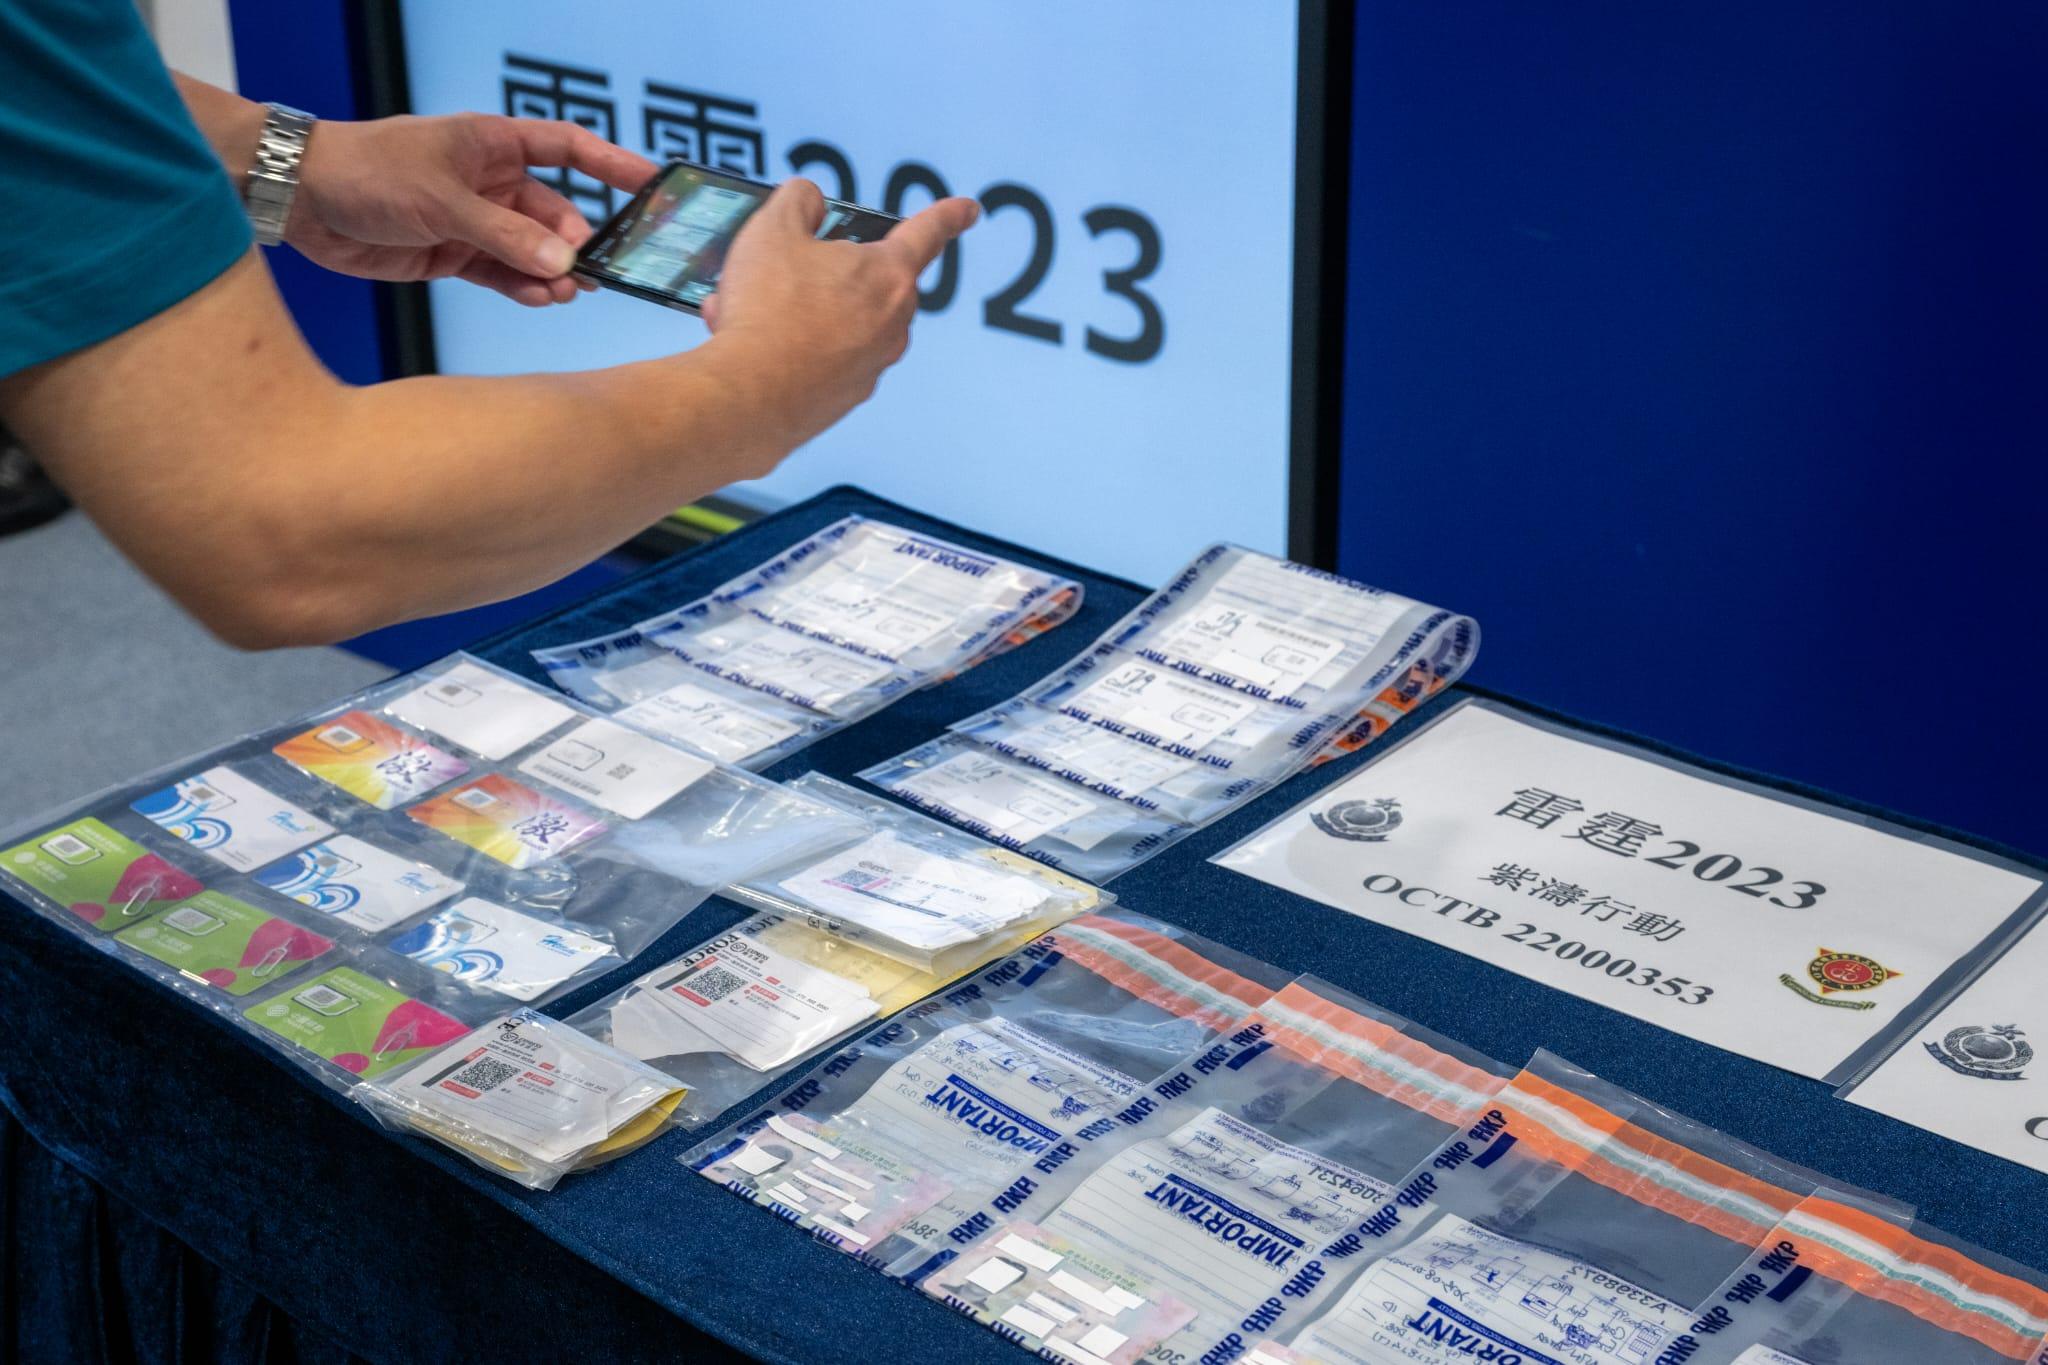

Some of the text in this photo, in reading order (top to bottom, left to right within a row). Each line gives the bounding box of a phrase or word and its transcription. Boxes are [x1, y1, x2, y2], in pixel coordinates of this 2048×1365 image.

[893, 541, 991, 579] IMPORTANT
[1494, 786, 1828, 910] 雷霆2023
[1362, 874, 1503, 929] OCTB
[1502, 922, 1714, 1005] 22000353
[1476, 862, 1686, 943] 紫濤行動
[925, 1084, 1050, 1156] MPORTANT
[1144, 1181, 1295, 1267] IMPORTANT
[1406, 1309, 1524, 1365] ORTANT
